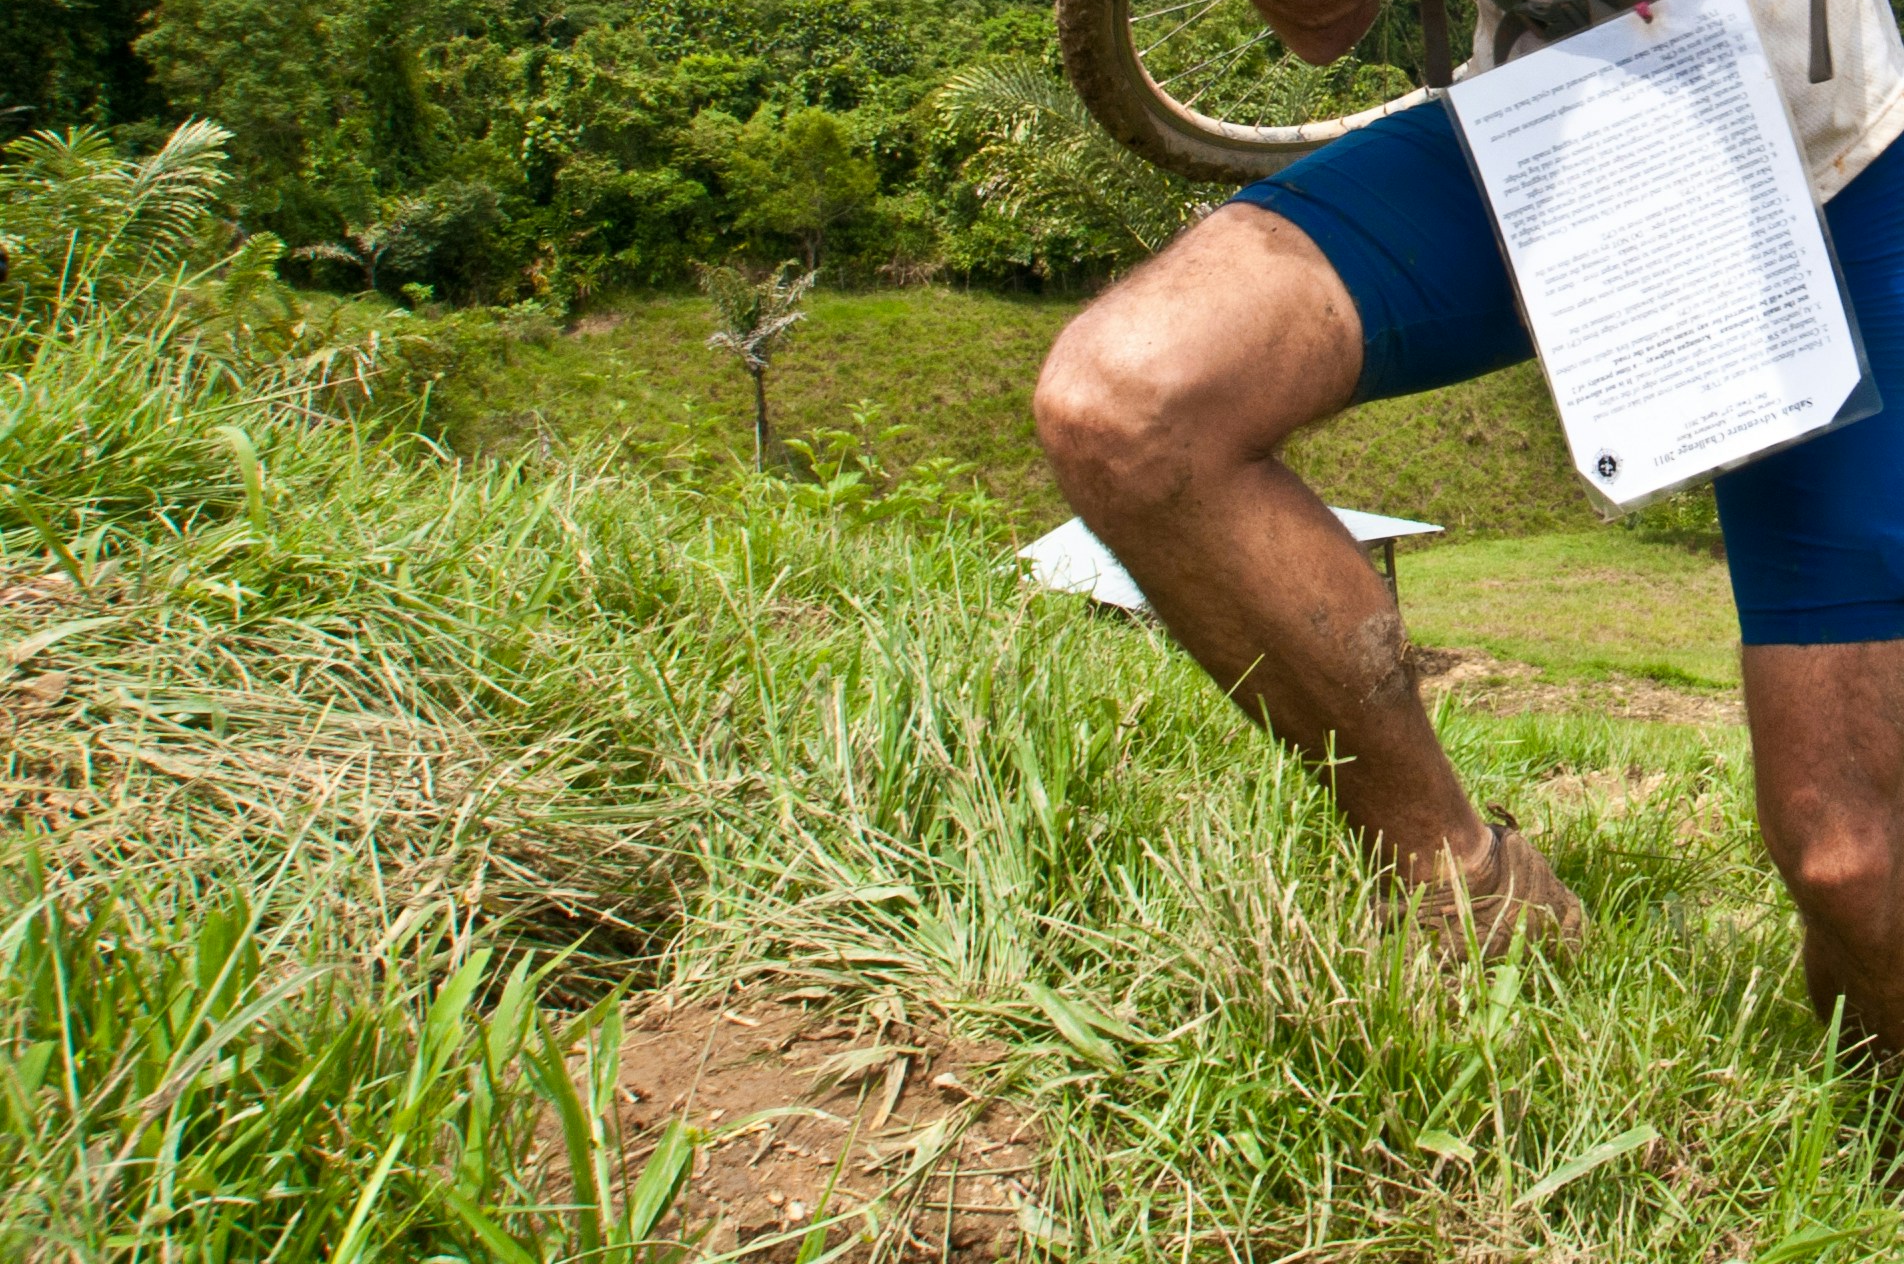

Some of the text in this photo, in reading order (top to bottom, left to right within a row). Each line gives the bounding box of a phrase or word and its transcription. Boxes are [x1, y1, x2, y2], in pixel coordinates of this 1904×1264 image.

[1653, 397, 1813, 466] Sabah Adventure Challenge 2011
